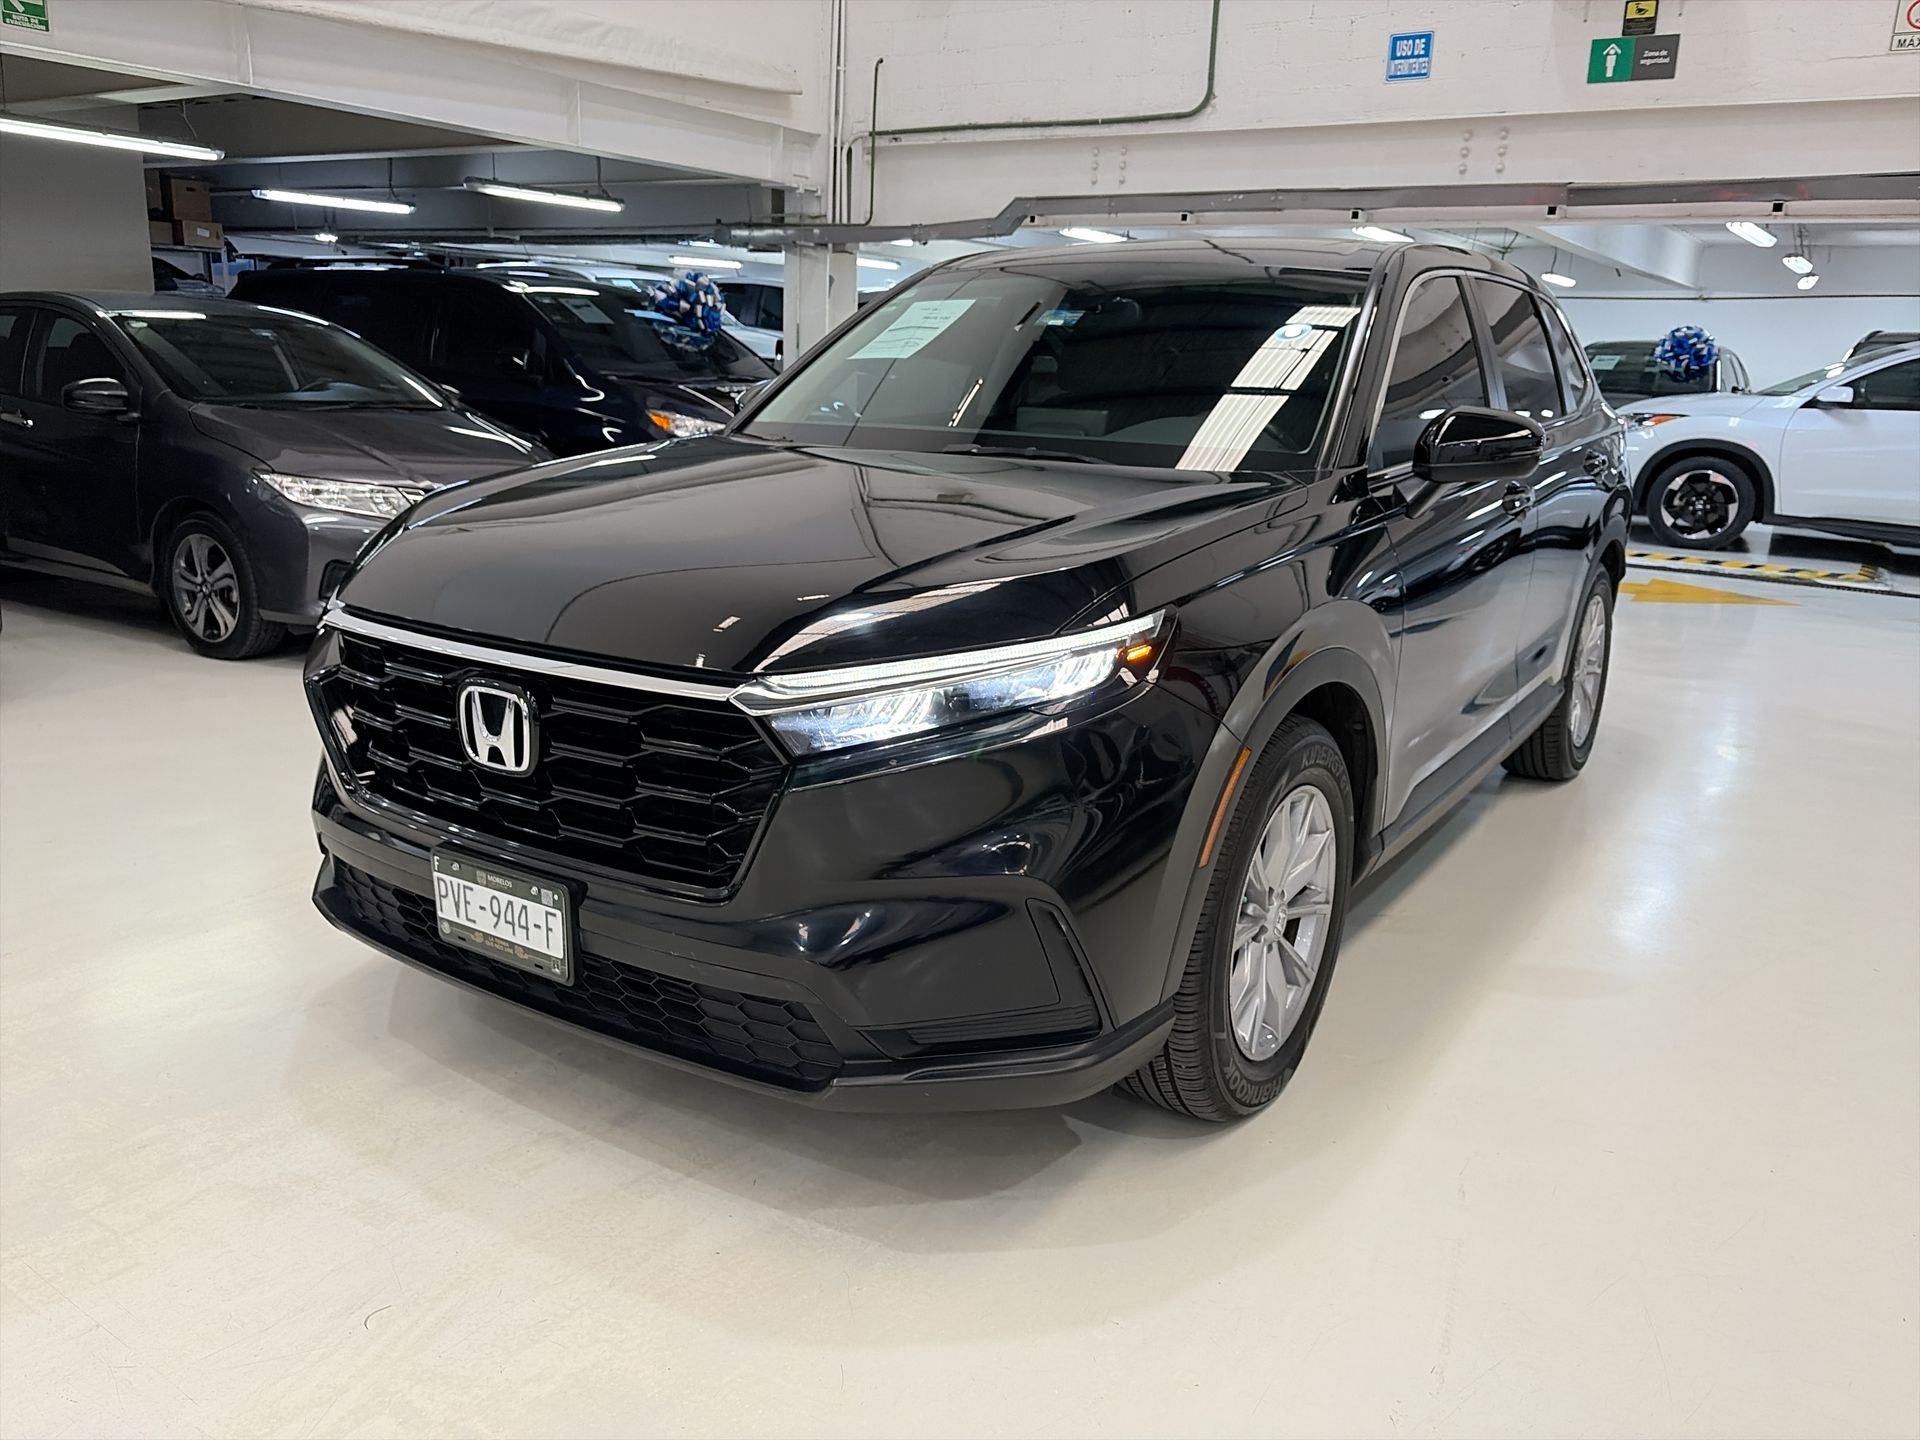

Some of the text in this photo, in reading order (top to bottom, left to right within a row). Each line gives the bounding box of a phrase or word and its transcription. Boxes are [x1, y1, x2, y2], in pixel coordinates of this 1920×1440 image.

[1396, 38, 1426, 57] USO DE
[433, 855, 441, 872] F
[487, 874, 513, 888] MORELOS
[436, 876, 557, 950] PVE-944-F
